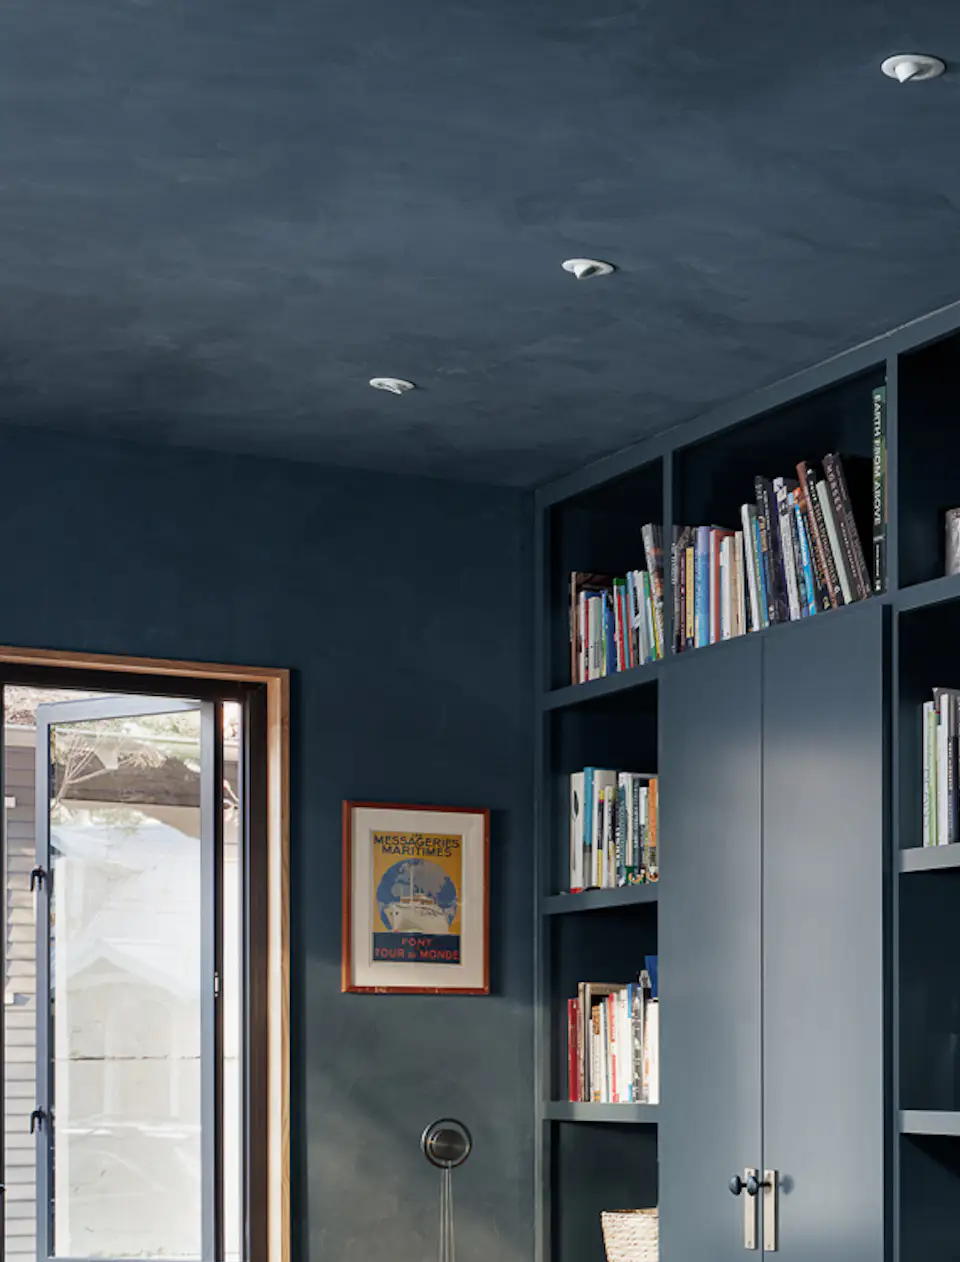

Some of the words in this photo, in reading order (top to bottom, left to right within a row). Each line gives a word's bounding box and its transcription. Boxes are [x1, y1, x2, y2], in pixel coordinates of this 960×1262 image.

[873, 394, 881, 436] EARTH
[373, 835, 460, 848] MESSAGERIES
[381, 846, 452, 857] MARITIMES
[375, 947, 405, 958] TOUR
[419, 949, 459, 960] MONDE
